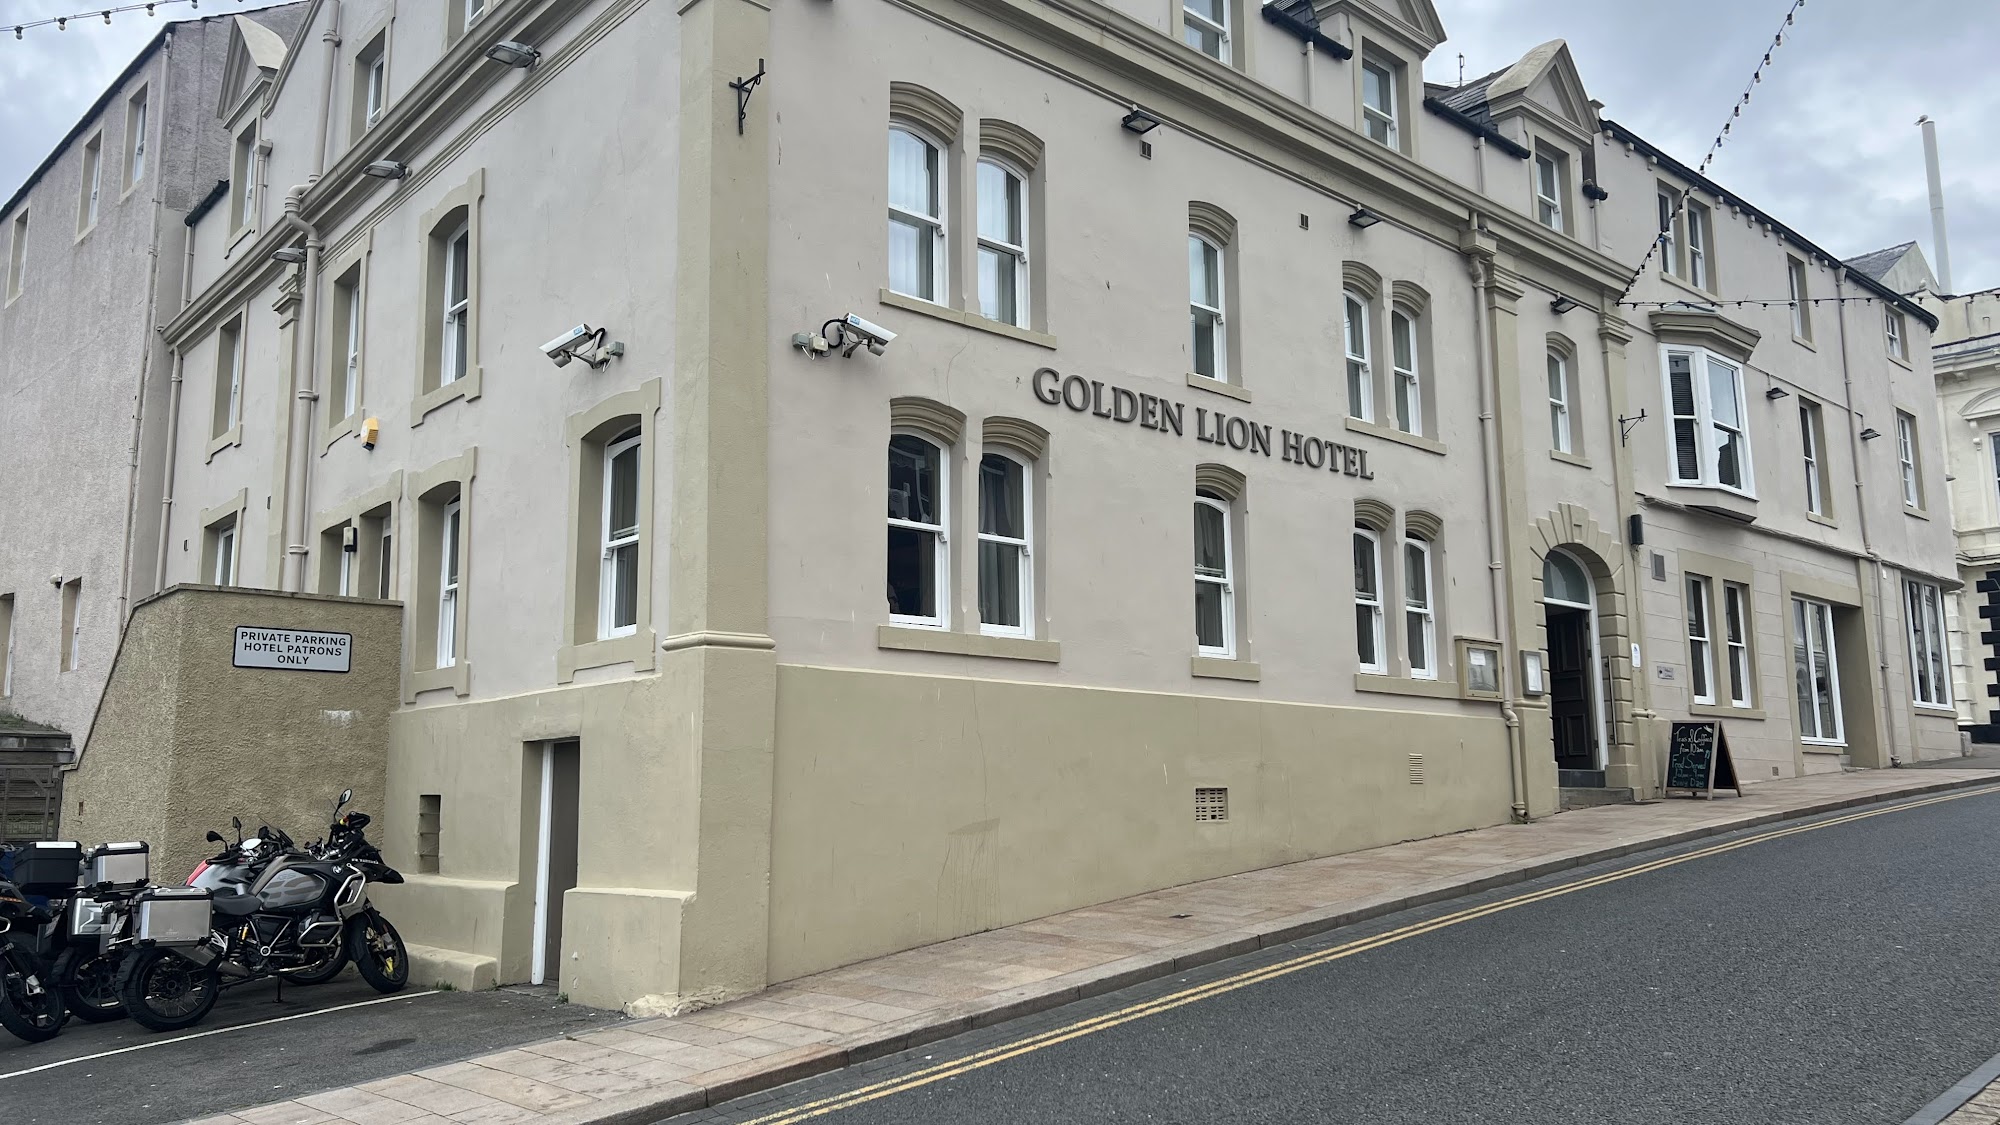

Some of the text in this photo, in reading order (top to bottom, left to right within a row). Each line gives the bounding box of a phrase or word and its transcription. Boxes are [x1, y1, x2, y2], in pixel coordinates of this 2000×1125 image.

[1033, 367, 1374, 480] GOLDEN LION HOTEL
[241, 631, 347, 646] PRIVATE PARKING
[244, 642, 342, 656] HOTEL PATRONS
[277, 655, 310, 665] ONLY
[1672, 754, 1685, 768] Food
[1690, 777, 1704, 788] Day
